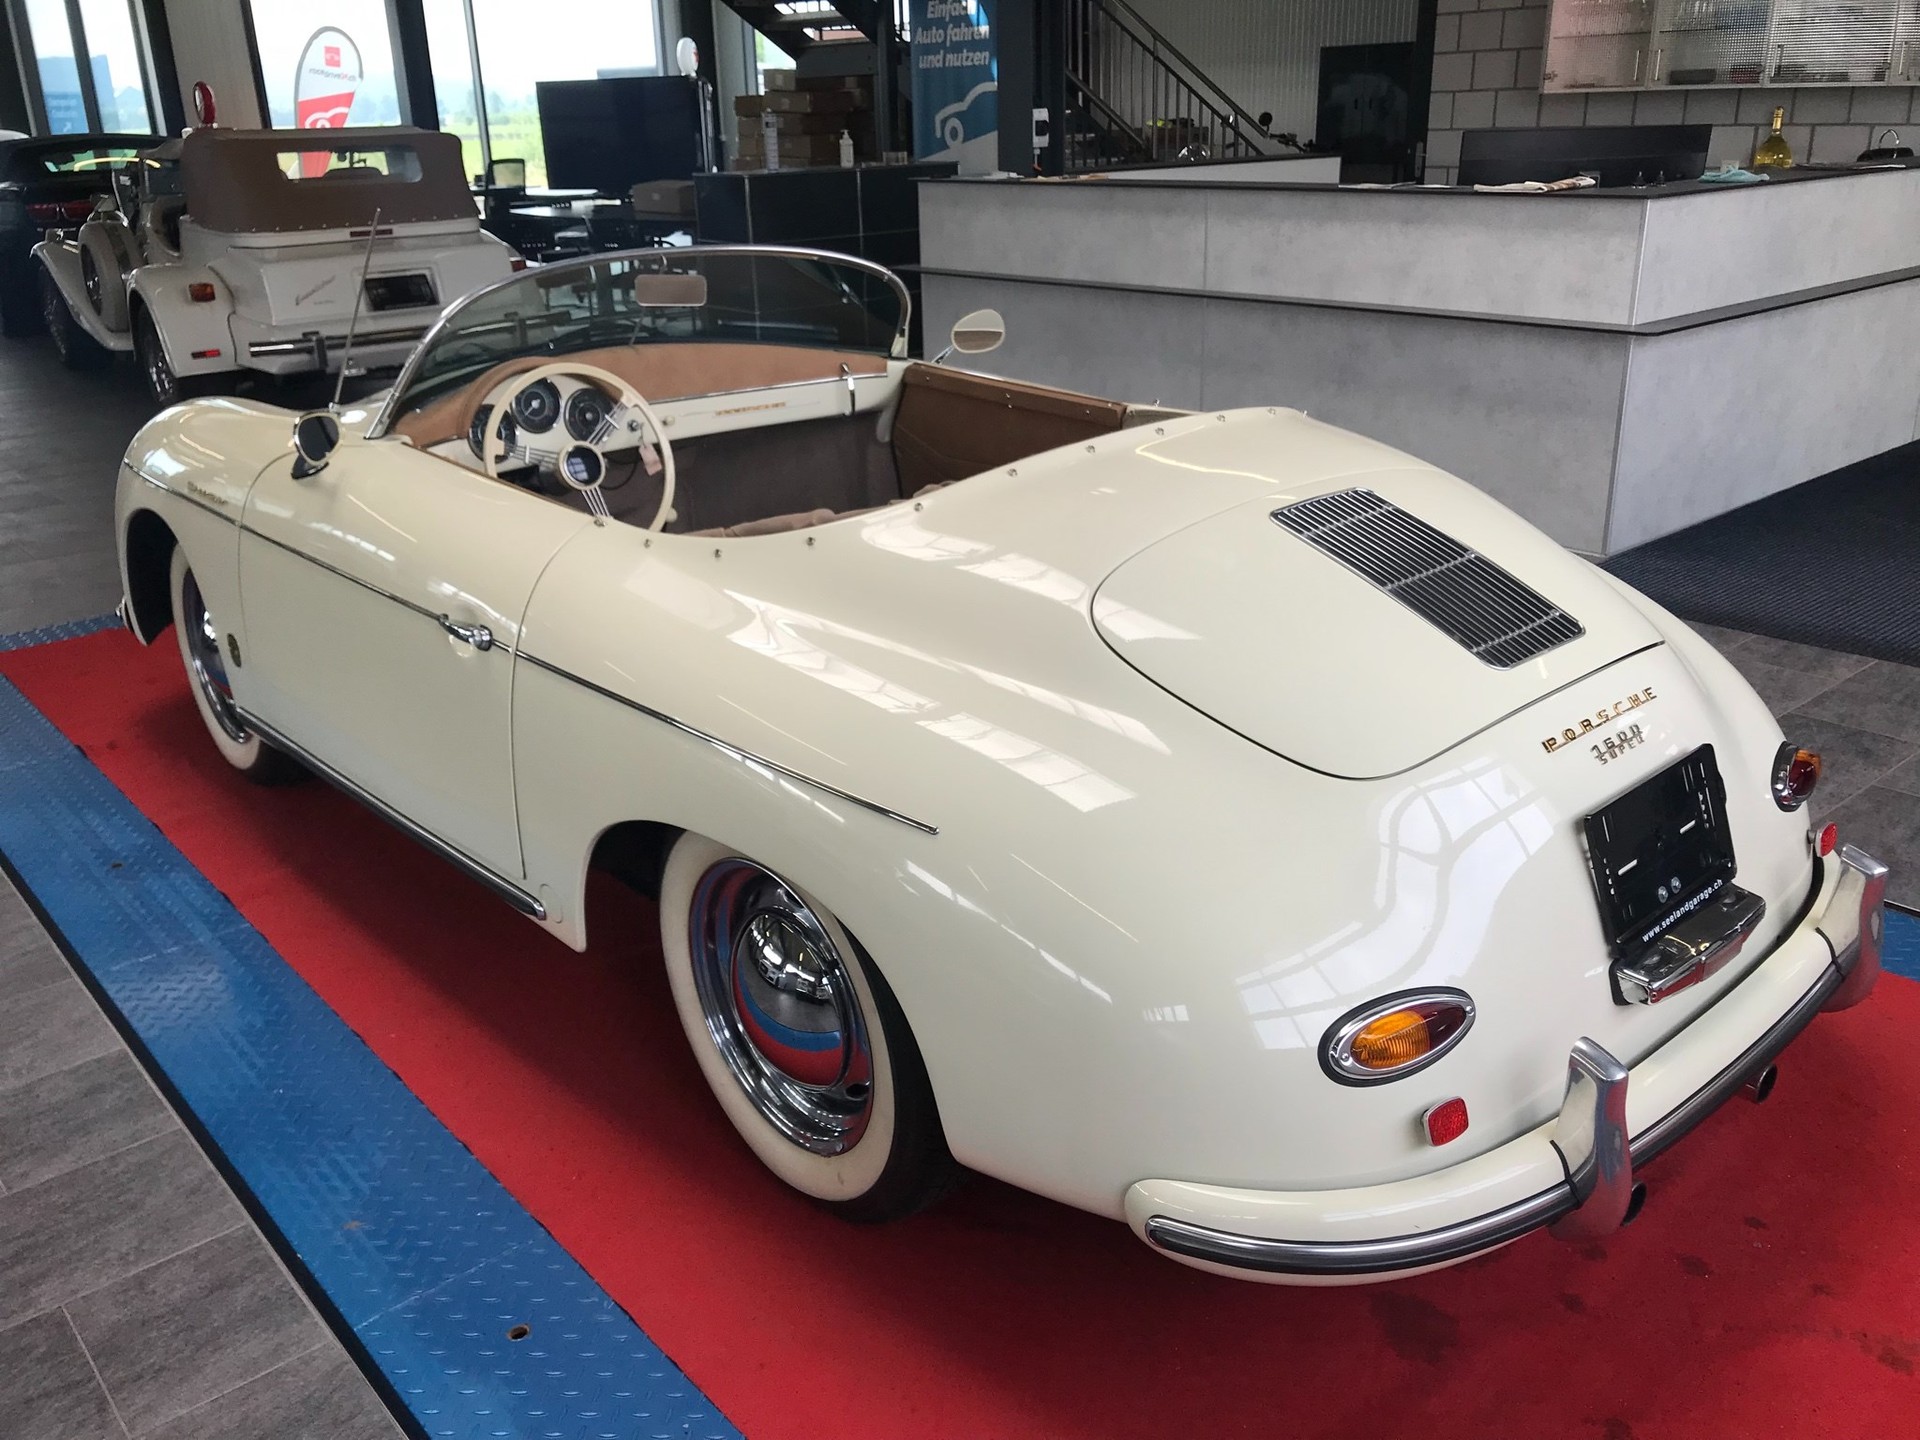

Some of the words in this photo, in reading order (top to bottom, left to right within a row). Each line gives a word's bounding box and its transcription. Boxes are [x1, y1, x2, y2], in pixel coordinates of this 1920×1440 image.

[926, 0, 979, 22] Einfach
[914, 26, 945, 44] Auto
[946, 23, 990, 47] fahren
[919, 49, 944, 69] und
[945, 49, 990, 68] nutzen
[1541, 686, 1658, 754] PORSCHE
[1589, 723, 1645, 760] 1600
[1597, 736, 1646, 766] SUPER
[1641, 878, 1724, 943] www.seelandgarage.ch
